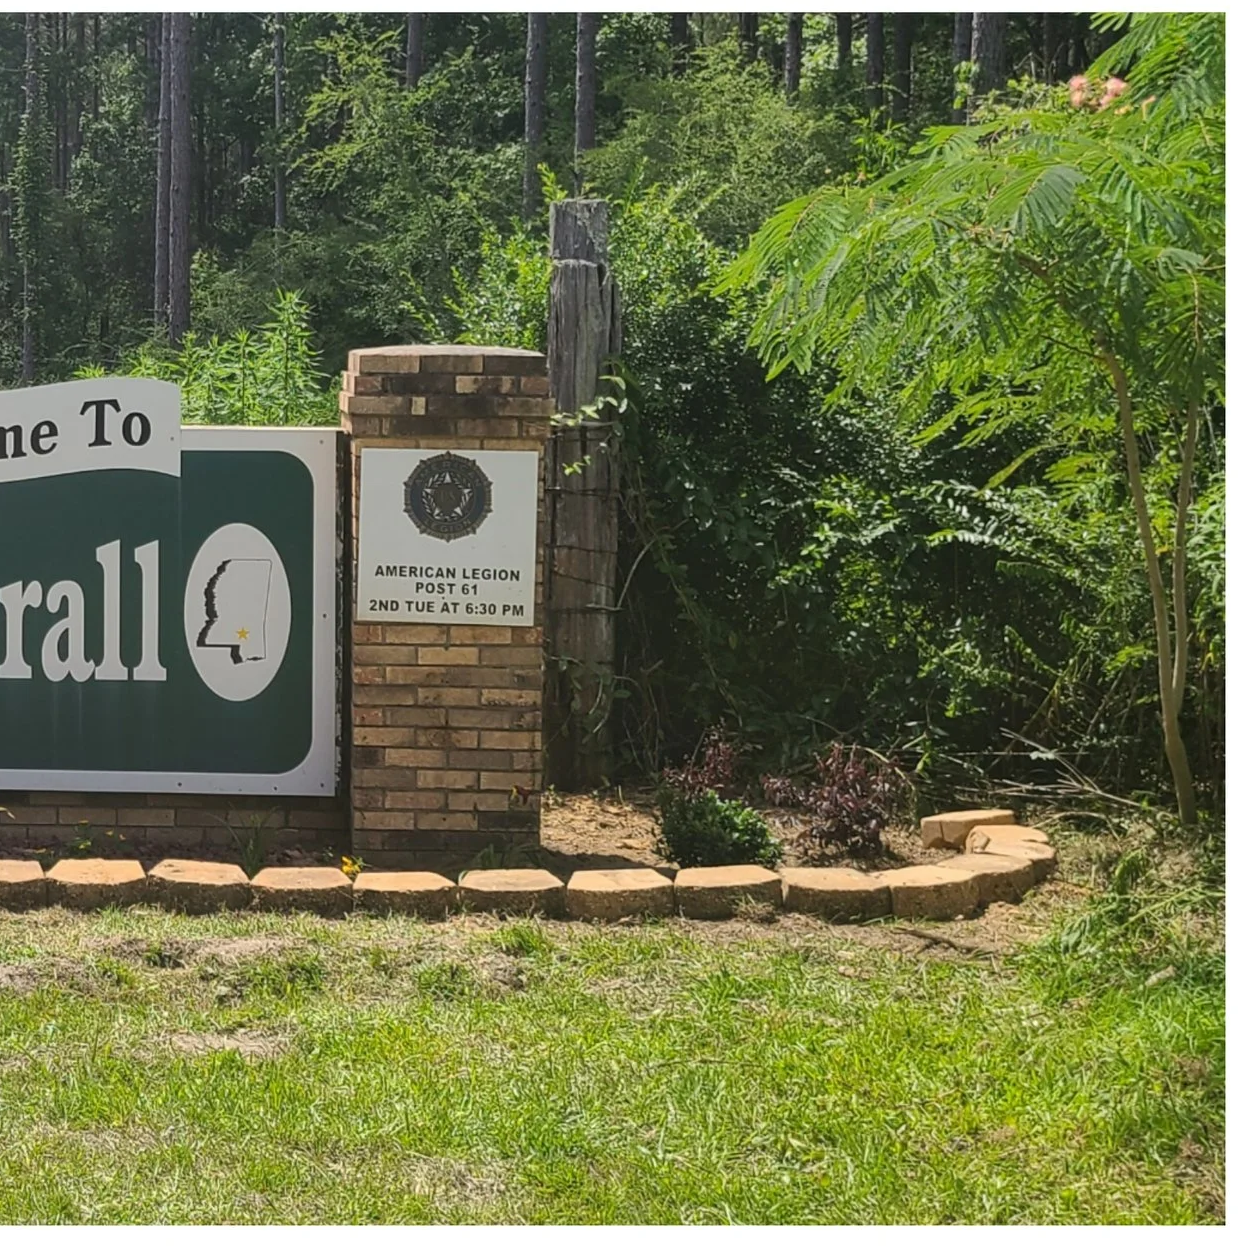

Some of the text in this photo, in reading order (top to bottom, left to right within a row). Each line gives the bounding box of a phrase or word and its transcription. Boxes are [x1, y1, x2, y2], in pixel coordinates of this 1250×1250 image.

[80, 399, 152, 447] To
[375, 565, 520, 581] AMERICAN LEGION
[415, 582, 478, 595] POST 61
[369, 599, 524, 616] 2ND TUE AT 6:30 PM
